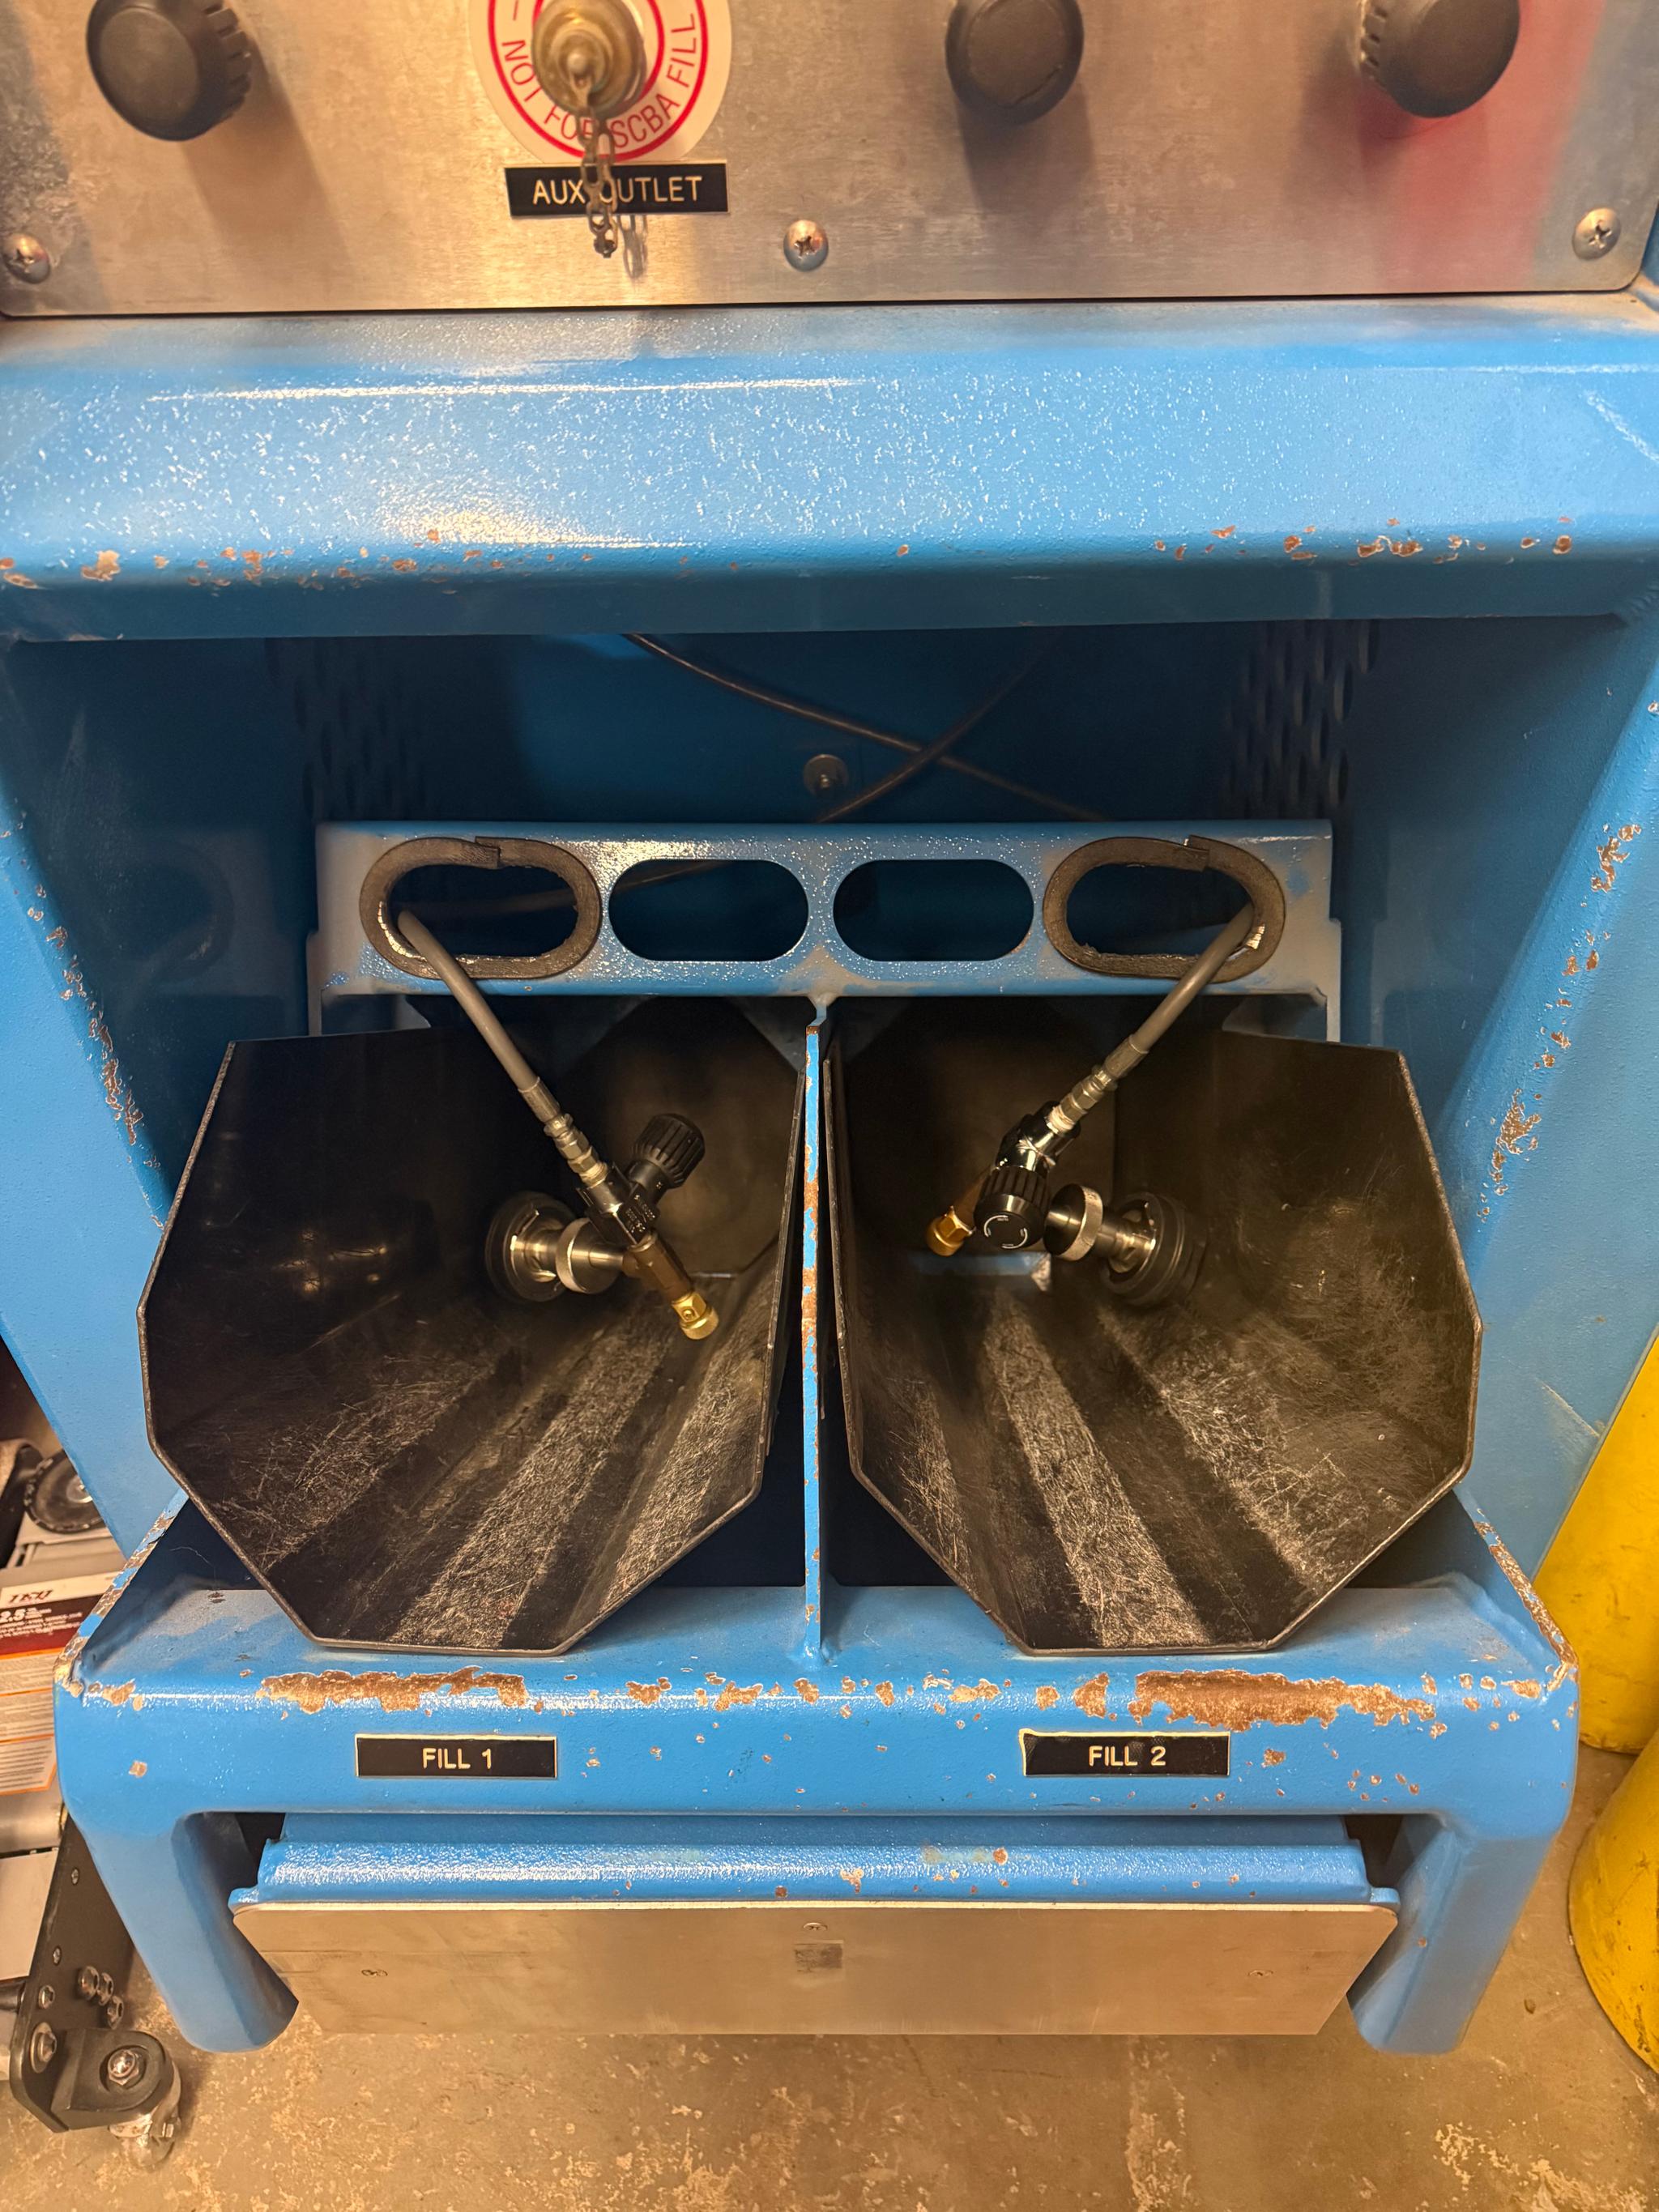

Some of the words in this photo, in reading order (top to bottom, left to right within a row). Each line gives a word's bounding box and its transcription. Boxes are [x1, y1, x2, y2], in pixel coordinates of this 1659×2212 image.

[610, 93, 681, 148] SCBA
[666, 13, 697, 87] FILL
[532, 179, 586, 205] AUX
[422, 1747, 471, 1770] FILL
[481, 1748, 493, 1770] 1
[1088, 1745, 1138, 1767] FILL
[1150, 1745, 1166, 1767] 2
